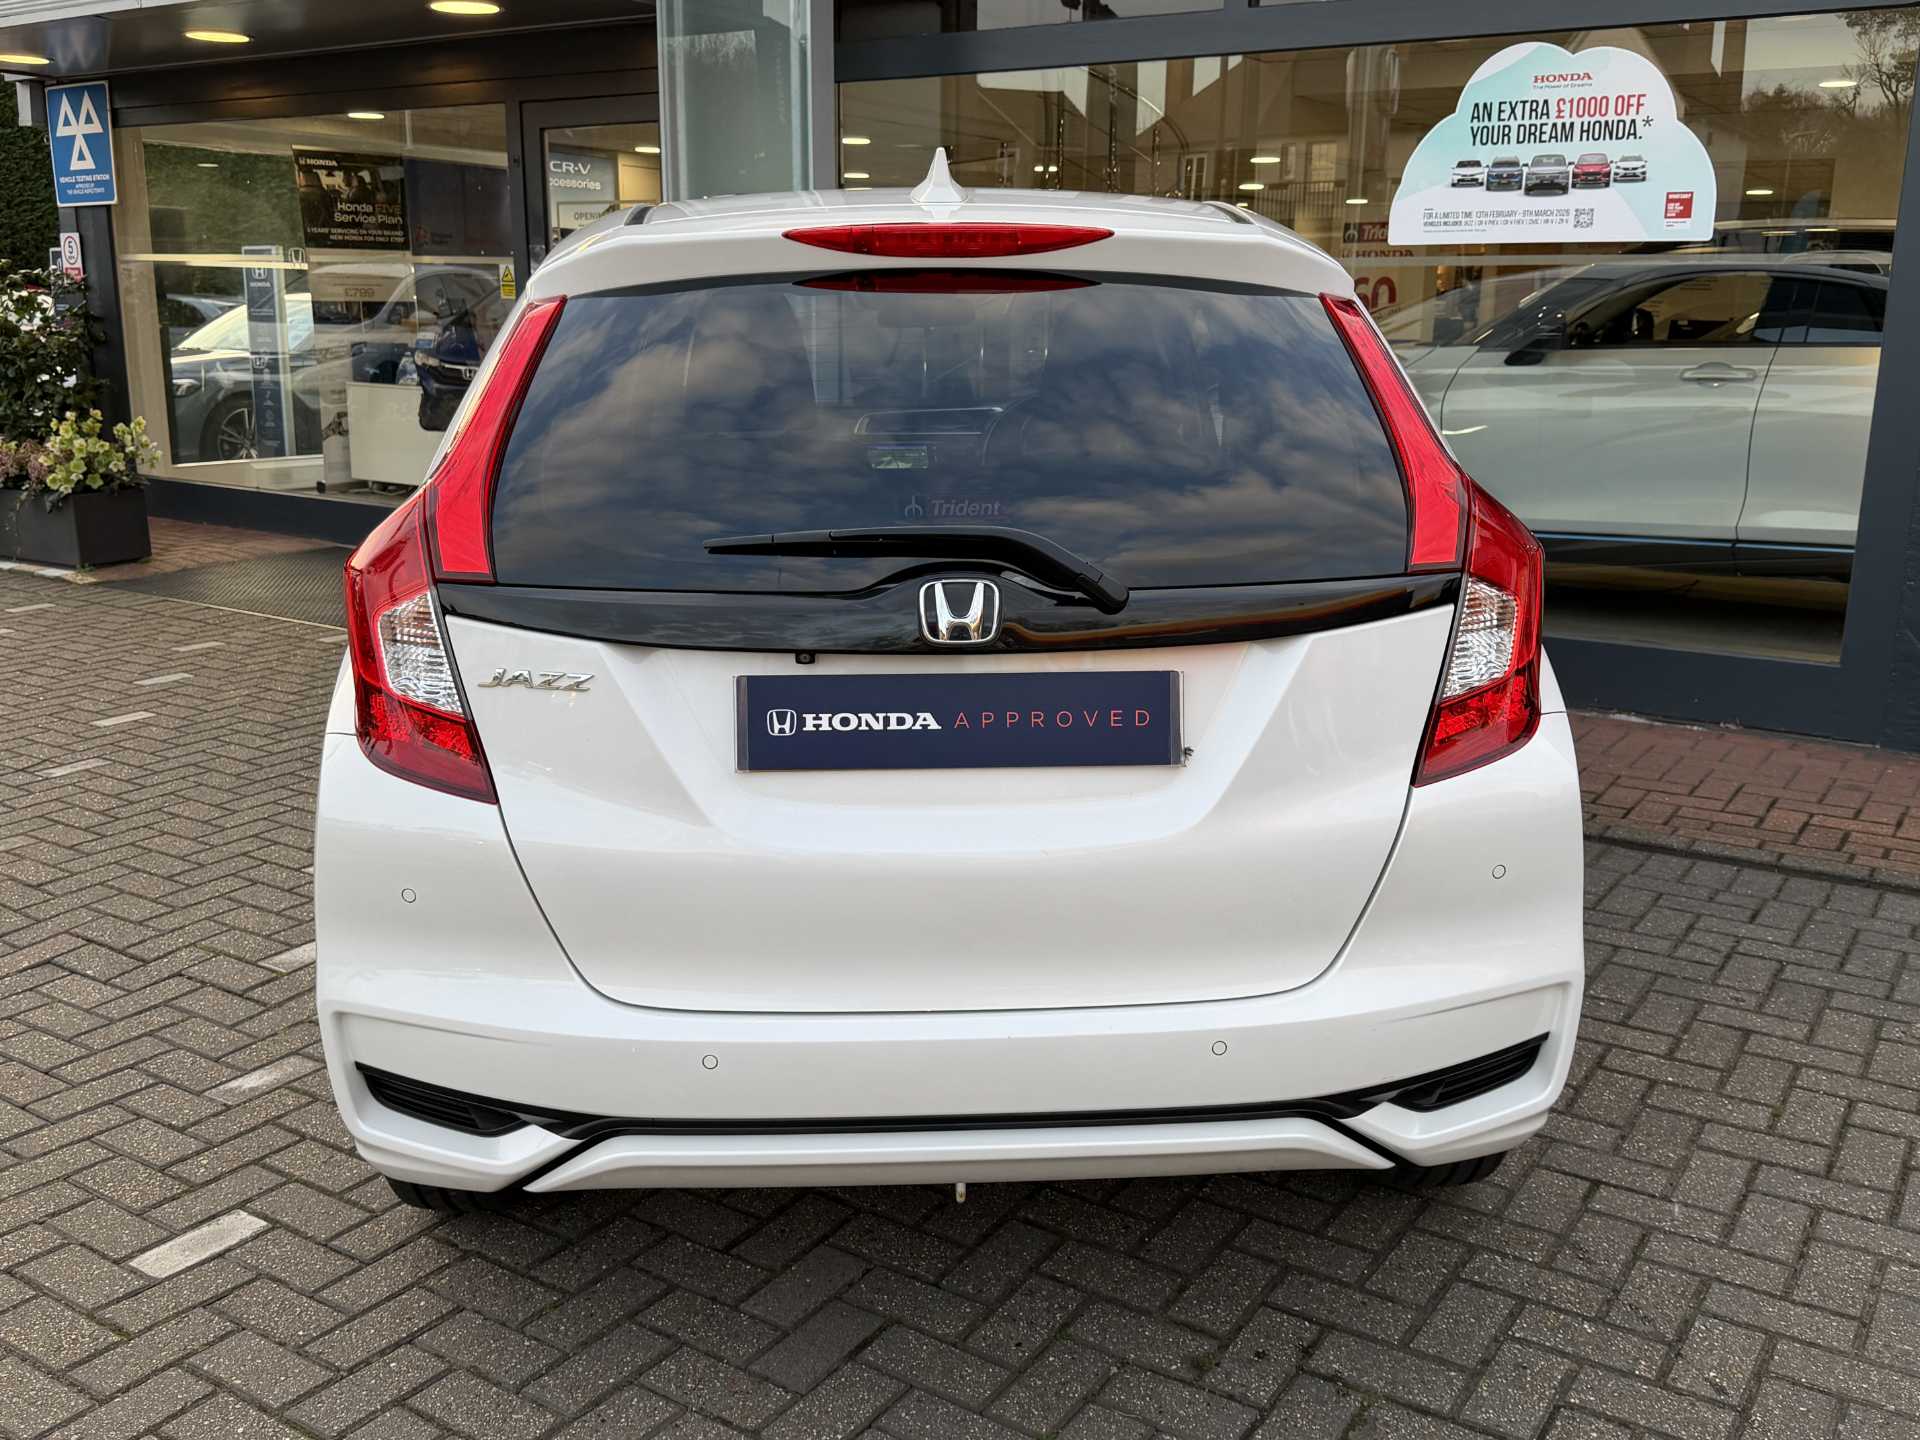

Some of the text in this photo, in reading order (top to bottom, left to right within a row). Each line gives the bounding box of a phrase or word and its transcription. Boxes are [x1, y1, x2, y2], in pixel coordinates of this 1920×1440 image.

[1533, 72, 1592, 83] HONDA
[1470, 94, 1647, 123] AN EXTRA £1000 OFF
[1470, 124, 1511, 146] YOUR
[1516, 121, 1575, 144] DREAM
[307, 159, 338, 167] HONDA
[337, 202, 401, 214] Honda FIVE
[1423, 211, 1434, 219] FOR
[1439, 210, 1460, 219] LIMITED
[1489, 209, 1518, 218] FEBRUARY
[1534, 208, 1554, 217] MARCH
[334, 212, 403, 225] Service Plan
[1362, 224, 1388, 240] Trid
[68, 240, 74, 253] 5
[931, 500, 1001, 517] Trident
[477, 668, 595, 692] JAZZ
[802, 709, 1151, 731] HONDA APPROVED
